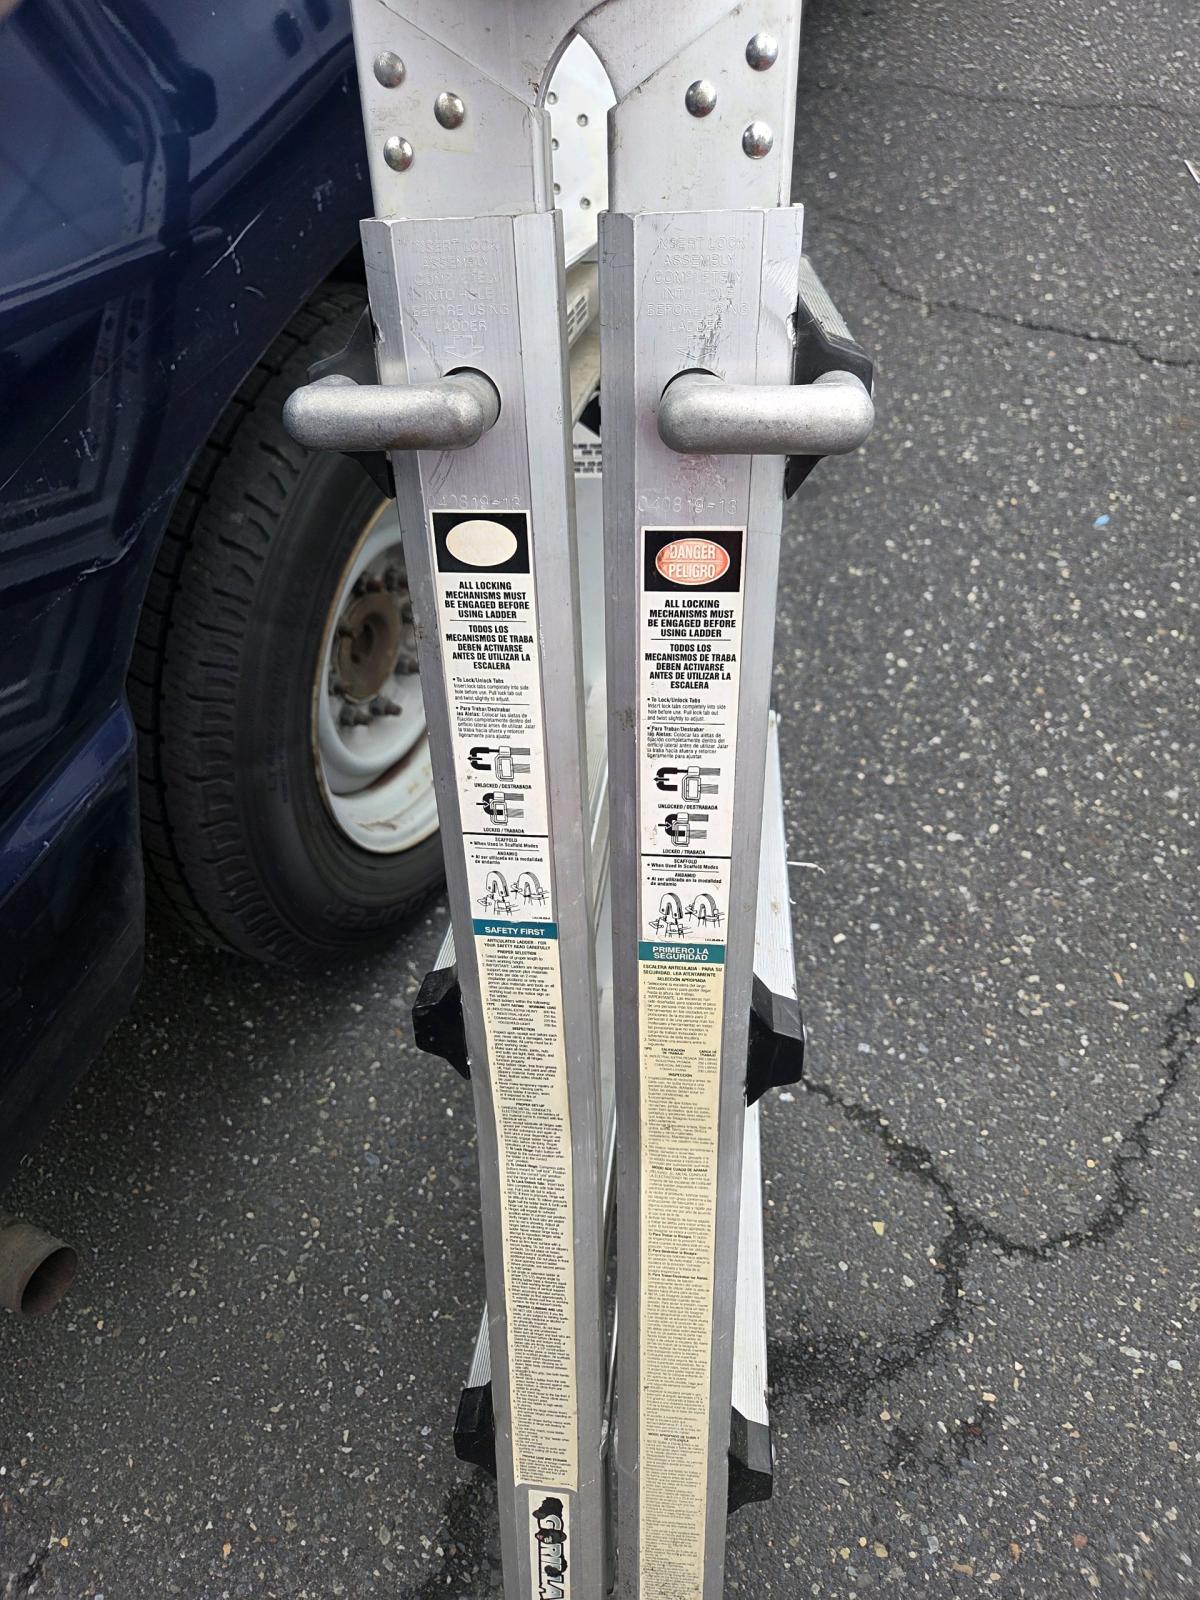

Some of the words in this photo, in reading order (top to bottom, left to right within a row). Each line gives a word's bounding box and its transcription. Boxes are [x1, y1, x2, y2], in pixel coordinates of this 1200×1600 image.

[670, 545, 716, 559] DANGER
[669, 564, 716, 578] PELIGRO
[446, 591, 501, 599] MECHANISMS
[682, 600, 719, 608] LOCKING
[650, 610, 707, 618] MECHANISMS
[645, 653, 697, 661] MECANISMOS
[653, 946, 694, 954] PRIMERO
